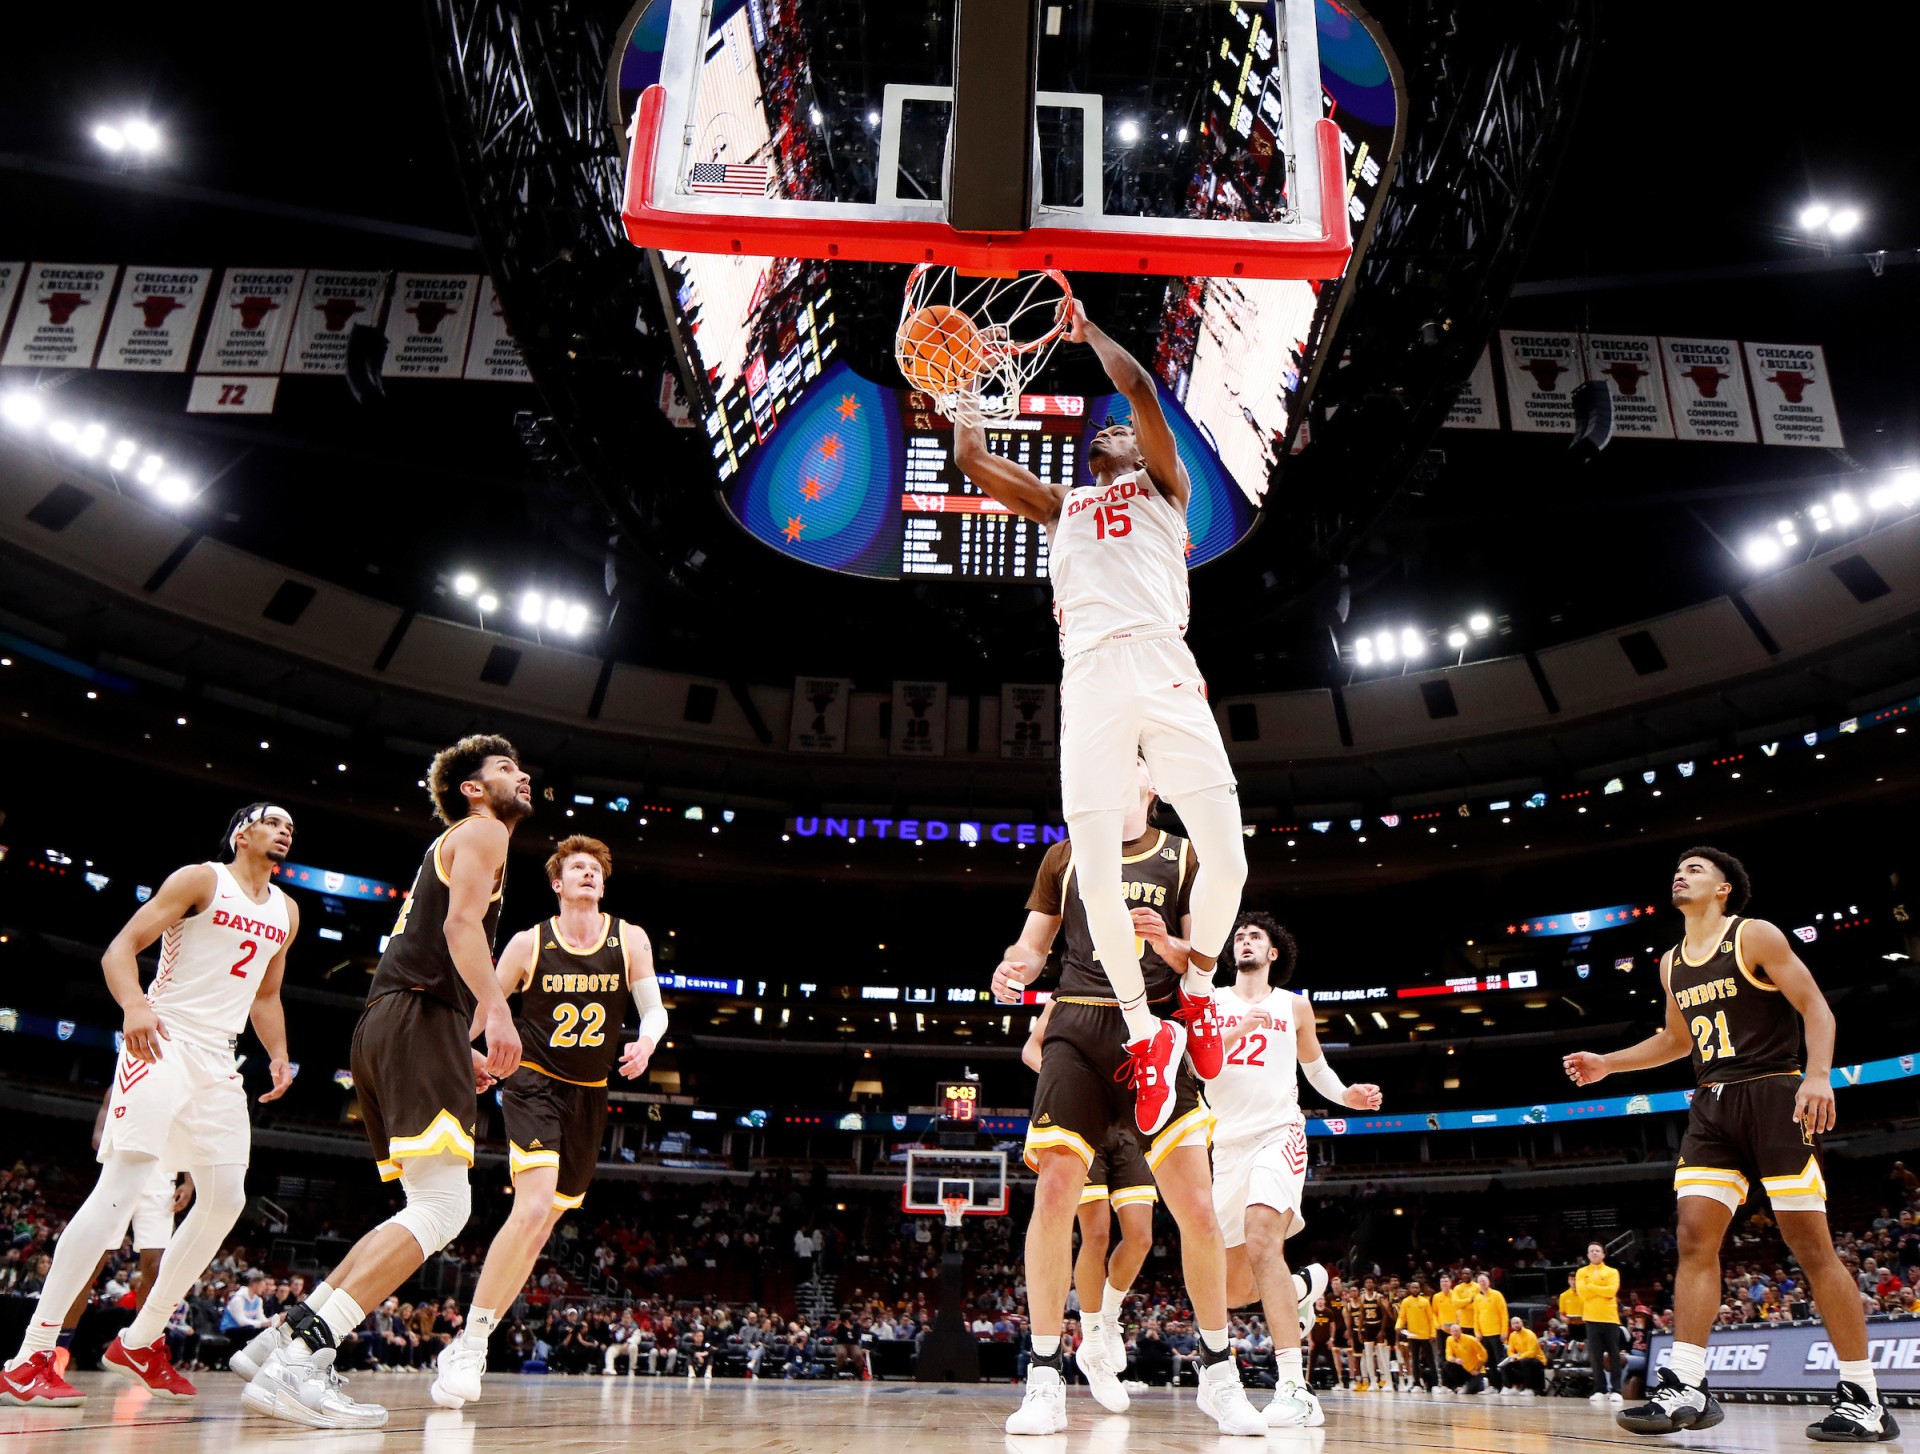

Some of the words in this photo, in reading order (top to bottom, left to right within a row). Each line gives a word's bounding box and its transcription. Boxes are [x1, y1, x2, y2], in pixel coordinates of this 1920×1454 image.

[40, 269, 104, 280] CHICAGO
[135, 273, 199, 284] CHICAGO
[233, 274, 293, 285] CHICAGO
[47, 281, 93, 291] BULLS
[315, 276, 377, 288] CHICAGO
[406, 280, 467, 290] CHICAGO
[141, 284, 188, 295] BULLS
[240, 286, 282, 295] BULLS
[322, 287, 366, 297] BULLS
[413, 290, 457, 300] BULLS
[230, 330, 265, 338] CENTRAL
[226, 340, 265, 348] DIVISION
[1511, 336, 1570, 348] CHICAGO
[1592, 340, 1648, 352] CHICAGO
[217, 350, 268, 358] CHAMPIONS
[404, 346, 444, 354] DIVISION
[1522, 348, 1564, 358] BULLS
[1671, 344, 1730, 355] CHICAGO
[1756, 348, 1814, 360] CHICAGO
[396, 355, 449, 364] CHAMPIONS
[1603, 352, 1643, 361] BULLS
[1683, 355, 1723, 364] BULLS
[1767, 360, 1808, 370] BULLS
[218, 384, 248, 406] 72
[1532, 392, 1566, 400] EASTERN
[1693, 400, 1728, 408] EASTERN
[1779, 405, 1814, 413] EASTERN
[1687, 410, 1738, 418] CONFERENCE
[1773, 414, 1823, 423] CONFERENCE
[1689, 419, 1739, 428] CHAMPIONS
[1775, 424, 1825, 432] CHAMPIONS
[1696, 428, 1735, 437] 1996-97
[1093, 502, 1132, 540] 15
[907, 720, 929, 738] 10
[795, 816, 950, 841] UNITED
[990, 822, 1067, 844] CEN
[212, 910, 287, 945] DAYTON
[230, 940, 258, 979] 2
[542, 974, 620, 993] COWBOYS
[686, 978, 728, 990] CENTER
[1313, 991, 1341, 1000] FIELD
[1342, 990, 1366, 1000] GOAL
[1366, 988, 1388, 998] PCT.
[1675, 977, 1738, 1010] COWBOYS
[549, 1002, 606, 1048] 22
[1691, 1010, 1736, 1064] 21
[1226, 1034, 1267, 1067] 22
[946, 1086, 976, 1100] 16:03
[952, 1100, 973, 1120] 13
